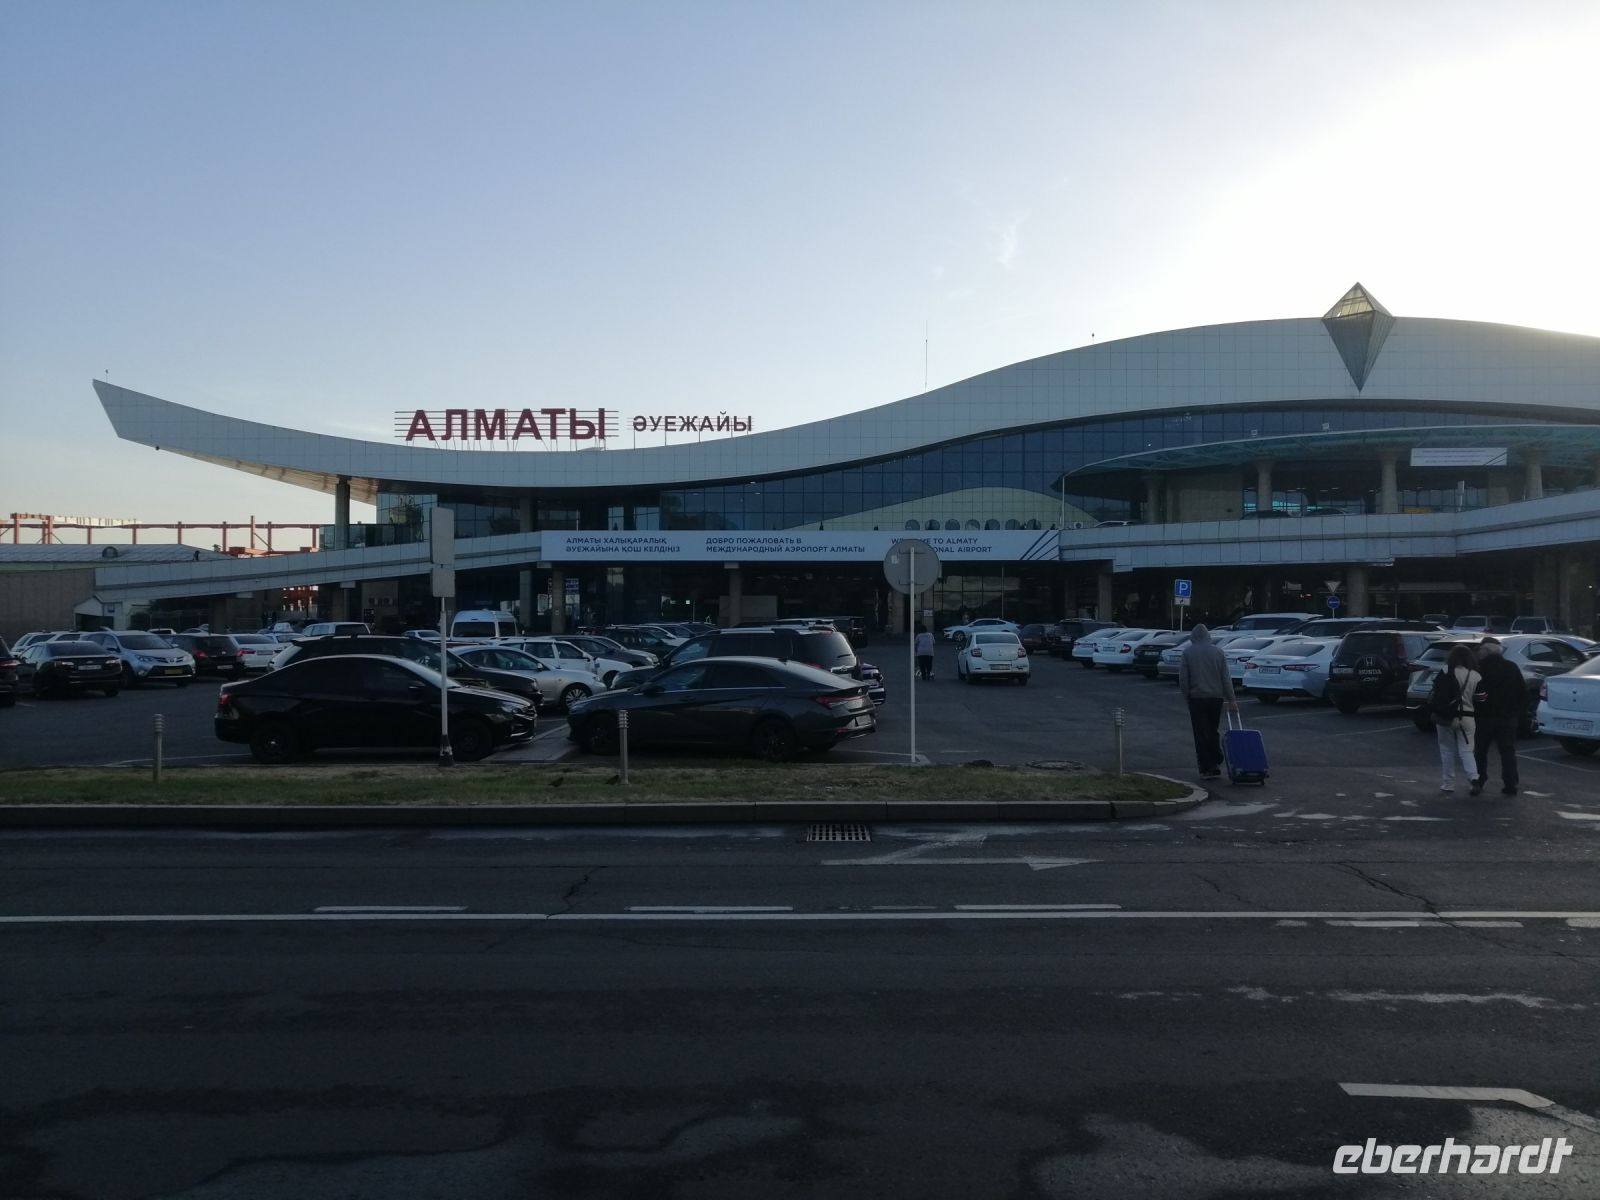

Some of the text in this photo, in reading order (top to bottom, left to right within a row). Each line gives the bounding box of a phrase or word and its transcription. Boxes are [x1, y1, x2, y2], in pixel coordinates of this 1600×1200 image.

[405, 408, 752, 441] АЛМАТЫ ӘУЕЖАЙЫ
[566, 537, 668, 546] АЛМАТЫ ХАЛЫҚАРАЛЫҚ
[706, 537, 802, 545] ДОБРО ПОЖАЛОВАТЬ В
[933, 537, 944, 545] TO
[946, 537, 978, 545] ALMATY
[566, 545, 620, 553] ӘУЕЖАЙЫНА
[621, 545, 642, 554] ҚОШ
[706, 545, 866, 554] МЕЖДУНАРОДНЫЙ АЭРОПОРТ АЛМАТЫ
[957, 545, 993, 553] AIRPORT
[1179, 582, 1189, 594] P
